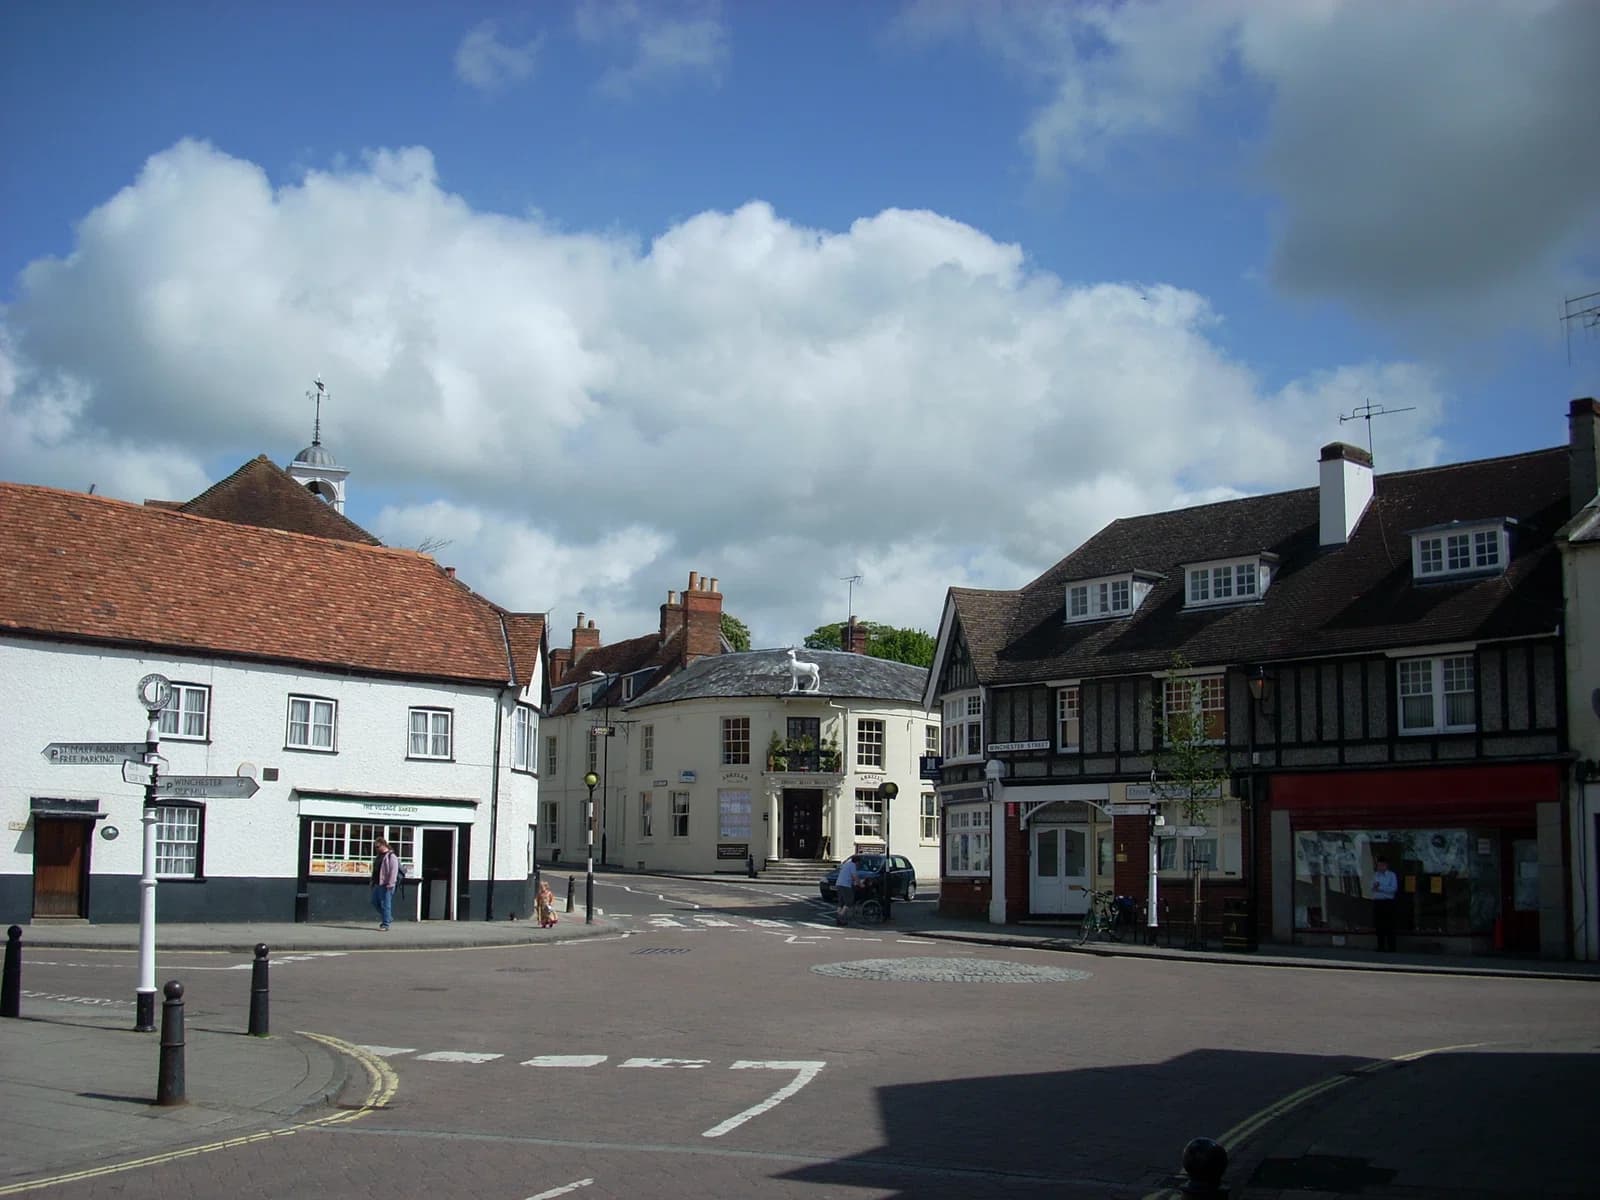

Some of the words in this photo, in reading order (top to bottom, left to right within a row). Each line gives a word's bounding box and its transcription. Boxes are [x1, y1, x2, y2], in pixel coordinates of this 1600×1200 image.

[71, 745, 94, 754] MARY
[97, 745, 126, 753] BOURNE
[51, 749, 59, 760] P
[60, 755, 77, 763] FREE
[81, 755, 114, 763] PARKING
[166, 782, 173, 791] P
[175, 779, 222, 787] WINCHESTER
[375, 803, 397, 811] VILLAGE
